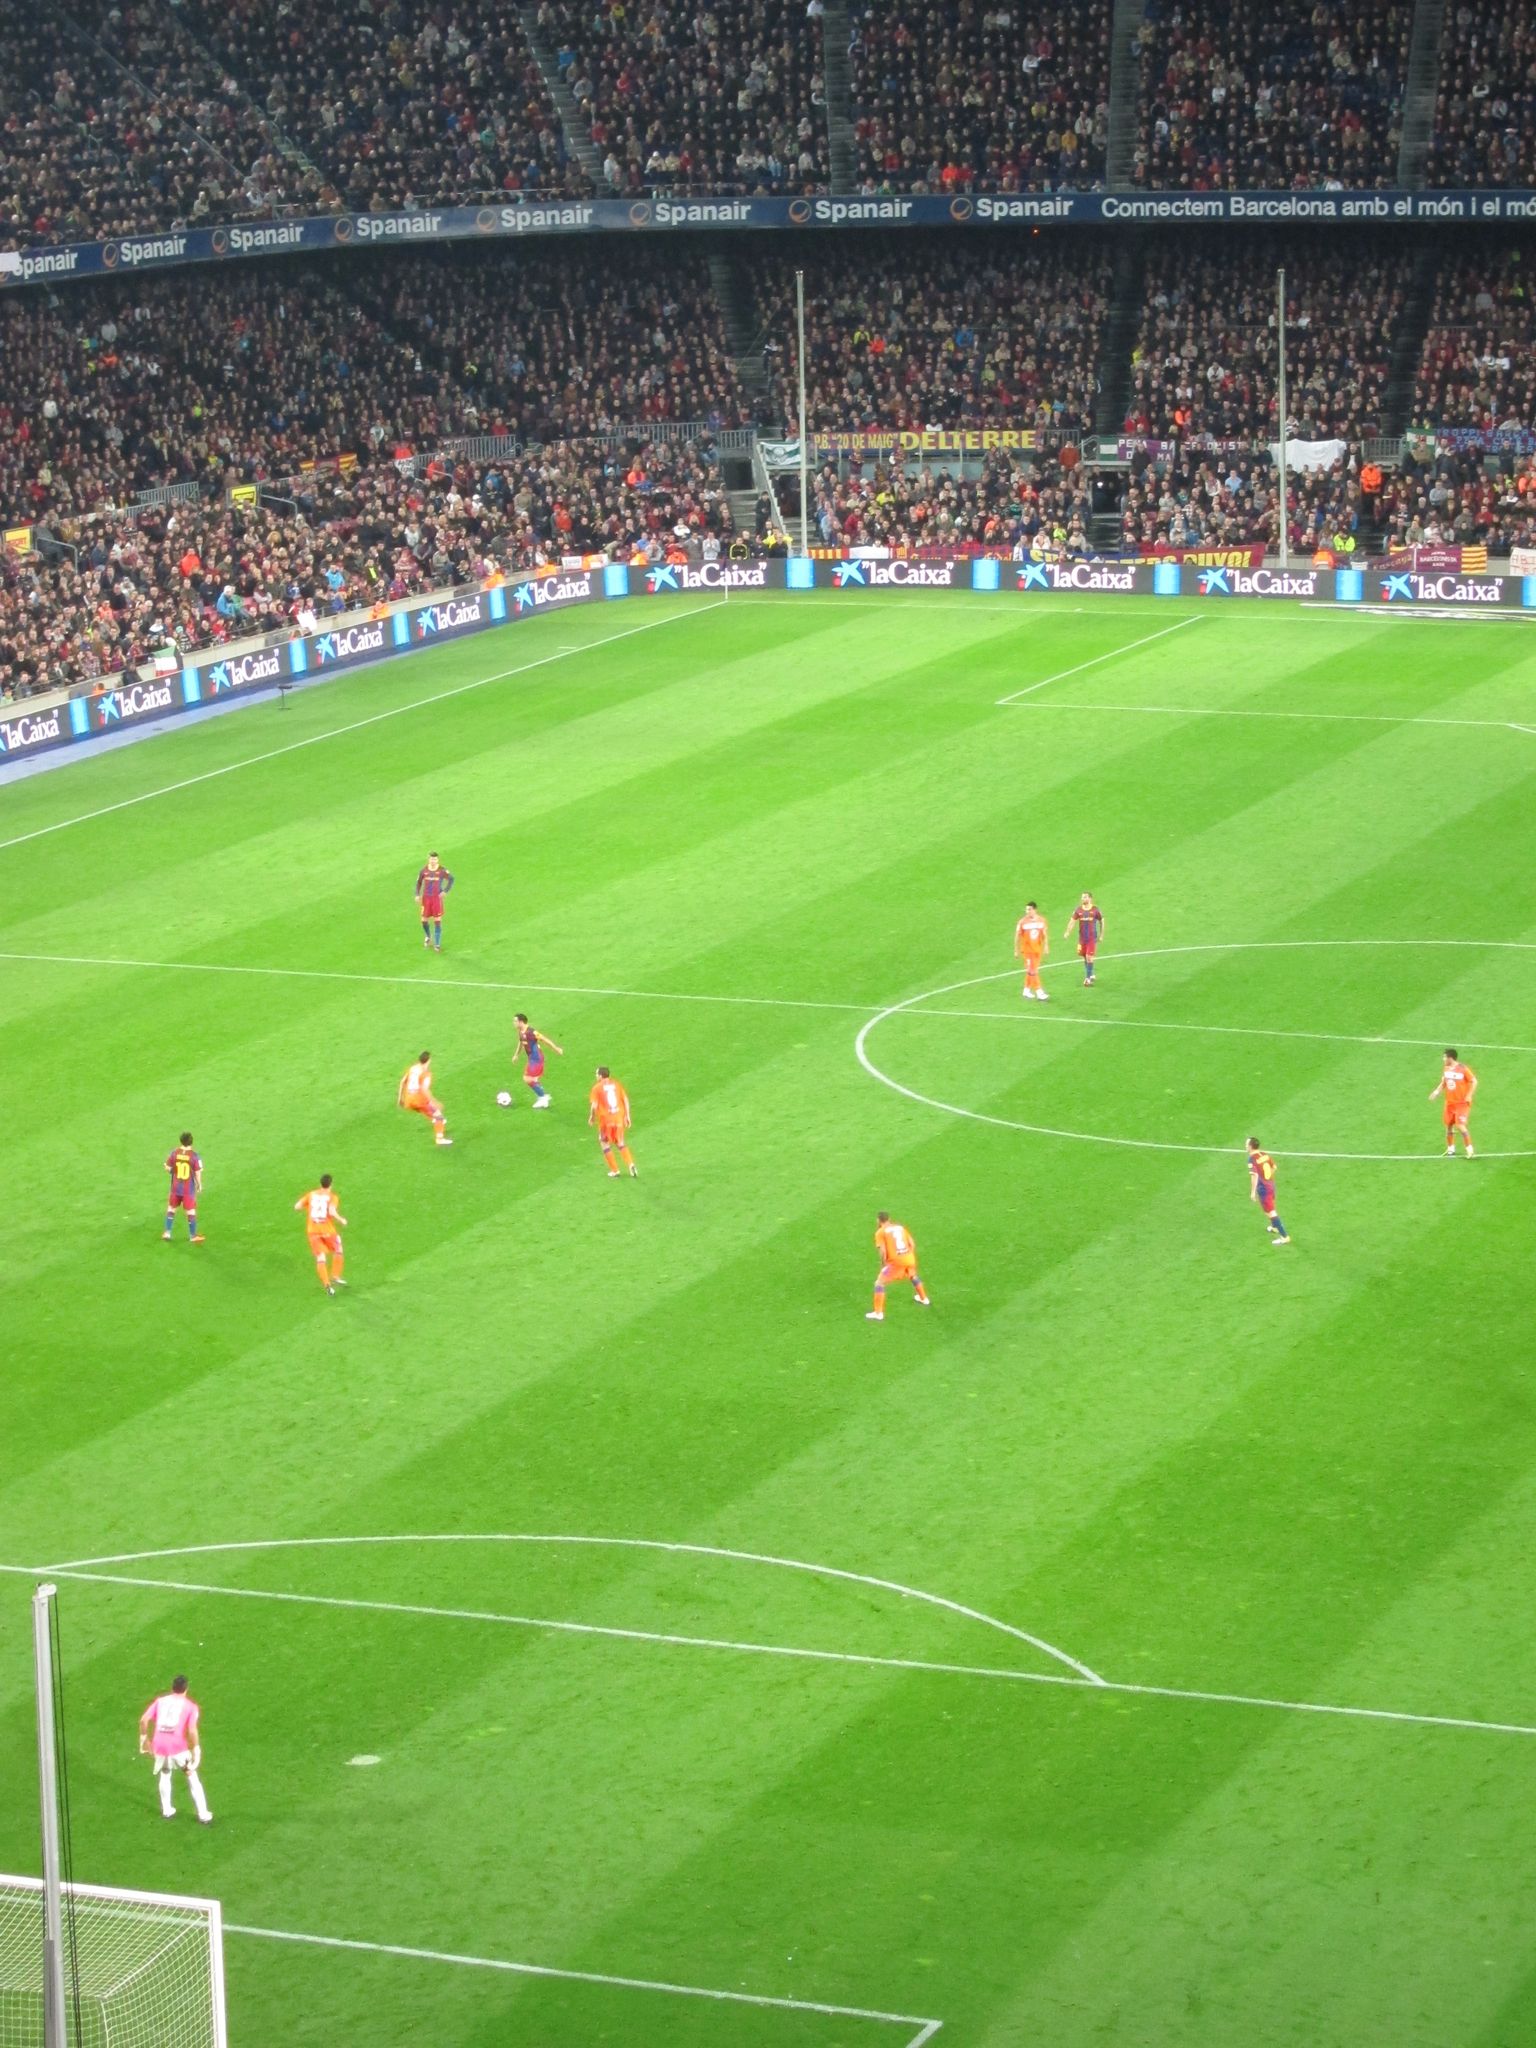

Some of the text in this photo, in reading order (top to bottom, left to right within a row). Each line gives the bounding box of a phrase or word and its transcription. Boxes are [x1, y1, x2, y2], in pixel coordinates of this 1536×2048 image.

[500, 204, 594, 232] Spanair
[655, 202, 753, 226] Spanair
[815, 199, 913, 223] Spanair
[977, 197, 1075, 221] Spanair
[1101, 197, 1224, 218] Connectem
[1229, 196, 1337, 217] Barcelona
[1341, 197, 1389, 217] amb
[1393, 196, 1413, 217] el
[1417, 196, 1465, 217] món
[1470, 197, 1477, 217] i
[1481, 197, 1501, 217] el
[230, 222, 304, 252] Spanair
[356, 212, 442, 241] Spanair
[120, 234, 186, 265] Spanair
[852, 432, 865, 449] DE
[175, 1161, 190, 1180] 10
